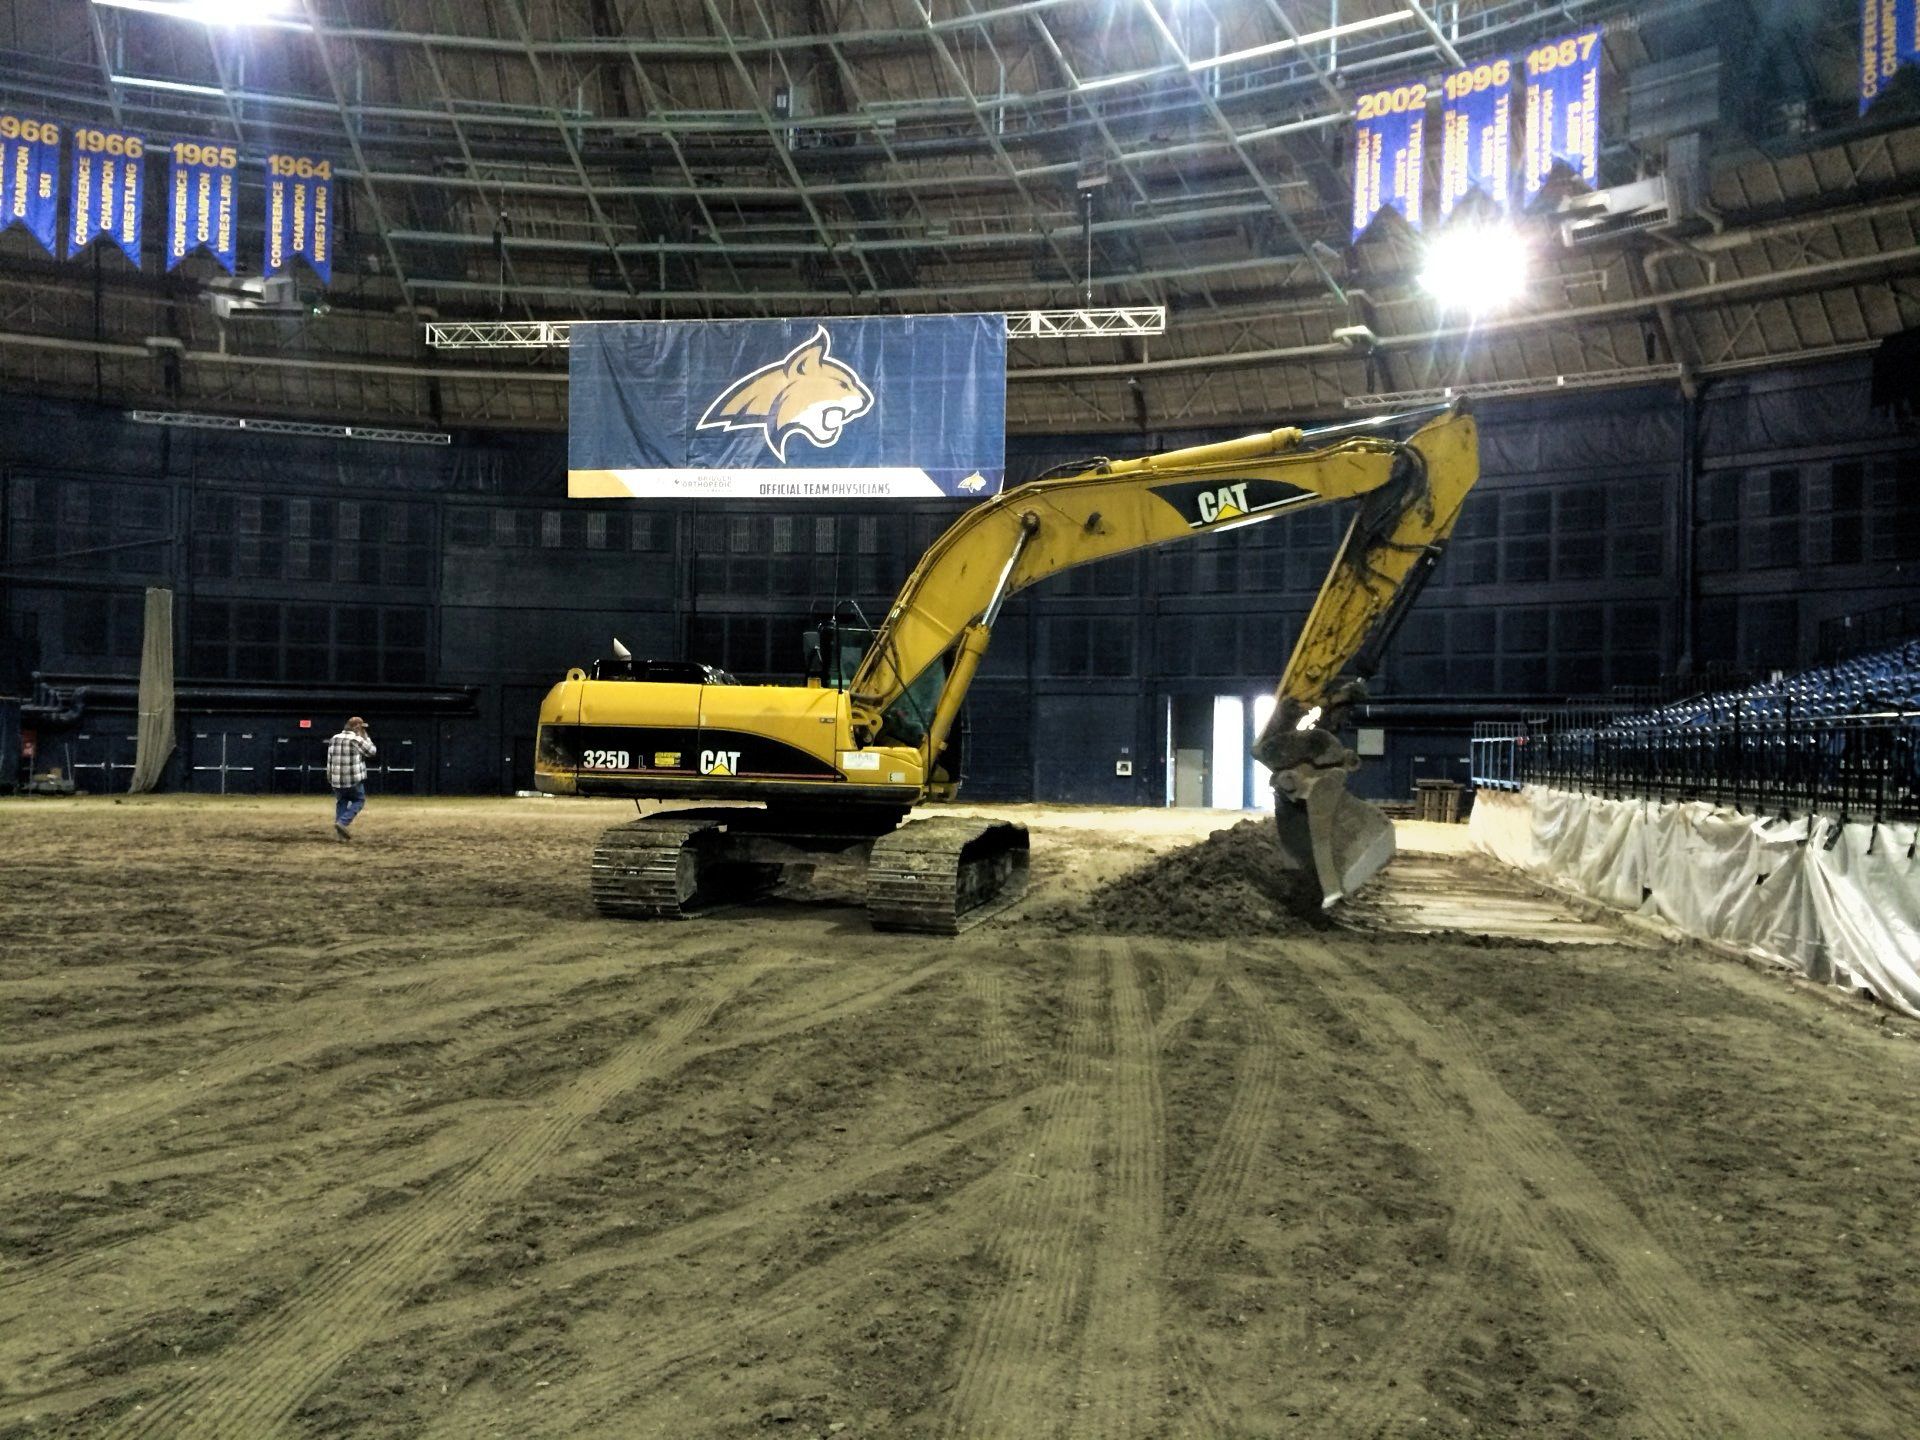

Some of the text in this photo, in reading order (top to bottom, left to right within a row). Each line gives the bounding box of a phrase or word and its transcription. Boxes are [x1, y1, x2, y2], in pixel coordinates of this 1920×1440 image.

[1445, 60, 1510, 99] 1996
[1528, 33, 1598, 76] 1987
[0, 116, 59, 145] 966
[1357, 85, 1427, 121] 2002
[75, 128, 143, 158] 1966
[173, 142, 237, 169] 1965
[268, 154, 331, 181] 1964
[14, 146, 29, 217] CHAMPION
[39, 173, 51, 198] SKI
[100, 160, 114, 230] CHAMPION
[1355, 128, 1369, 229] CONFERENCE
[1406, 120, 1423, 222] BASKETBALL
[75, 157, 90, 245] CONFERENCE
[122, 163, 137, 242] WRESTLING
[173, 170, 187, 256] CONFERENCE
[197, 173, 210, 242] CHAMPION
[218, 175, 232, 252] WRESTLING
[270, 182, 283, 267] CONFERENCE
[293, 184, 306, 251] CHAMPION
[314, 186, 327, 262] WRESTLING
[760, 483, 890, 495] OFFICIAL TEAM PHYSICIANS
[1197, 482, 1249, 523] CAT
[583, 750, 629, 769] 325D
[700, 750, 741, 776] CAT
